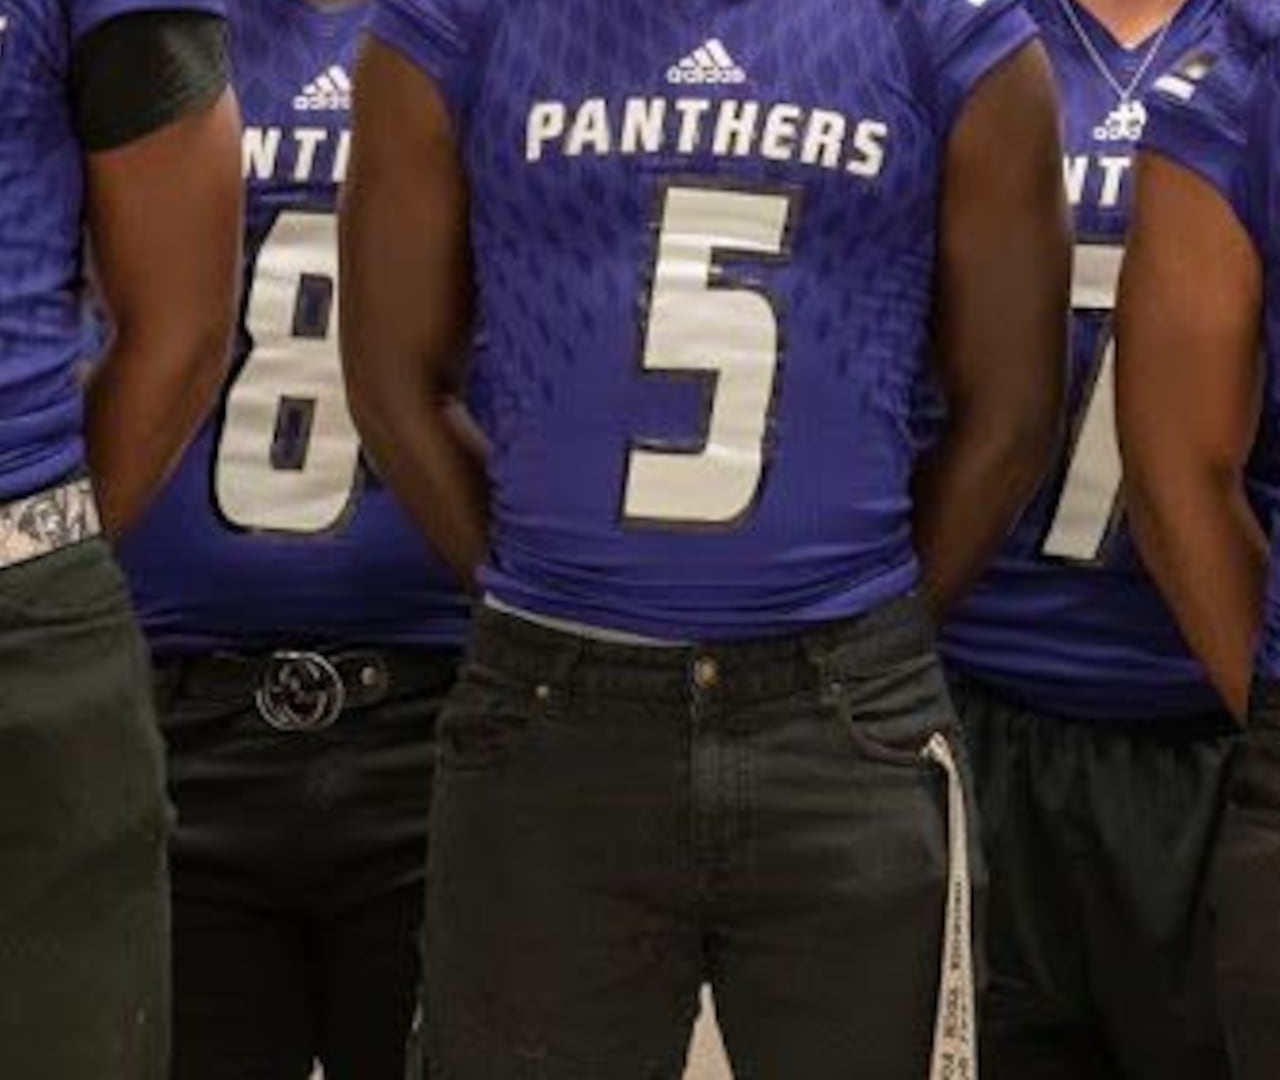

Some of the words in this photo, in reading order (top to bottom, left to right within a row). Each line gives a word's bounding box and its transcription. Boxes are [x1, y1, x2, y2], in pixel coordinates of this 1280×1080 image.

[525, 97, 888, 176] PANTHERS
[214, 212, 362, 534] 8
[621, 186, 791, 523] 5
